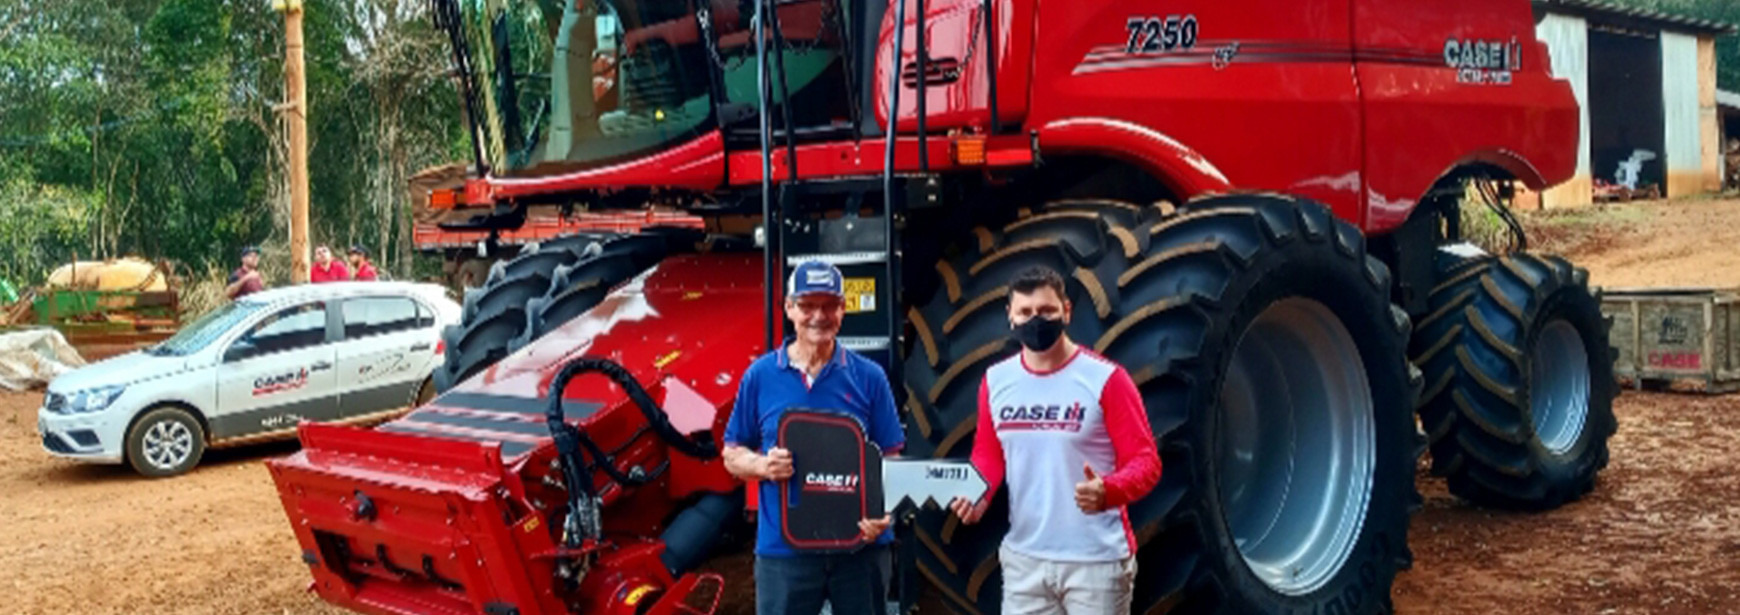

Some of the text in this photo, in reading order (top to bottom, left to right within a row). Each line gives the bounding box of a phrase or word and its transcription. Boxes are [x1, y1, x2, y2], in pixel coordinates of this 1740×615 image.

[1125, 14, 1198, 54] 7250
[1443, 38, 1502, 68] CASE
[1647, 350, 1702, 369] CASE
[1000, 404, 1060, 421] CASE
[805, 472, 843, 487] CASE
